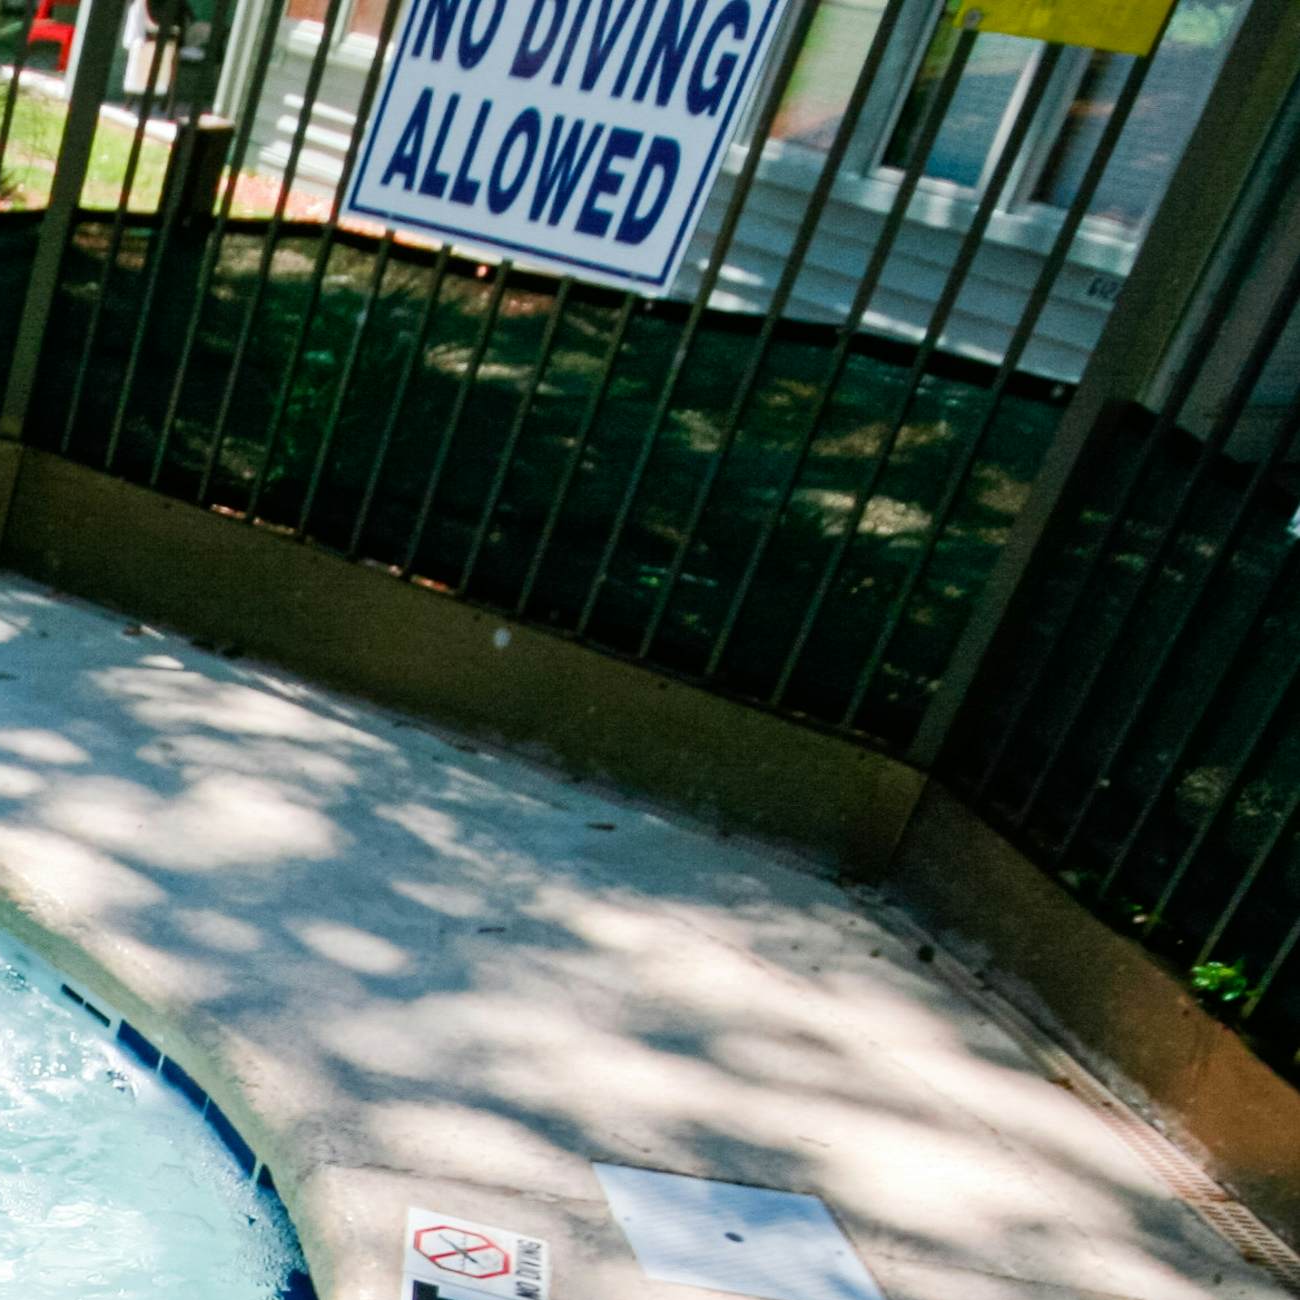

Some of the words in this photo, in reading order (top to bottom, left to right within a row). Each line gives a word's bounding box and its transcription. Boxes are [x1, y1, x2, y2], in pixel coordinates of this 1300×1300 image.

[411, 0, 508, 71] NO
[508, 0, 751, 117] DIVING
[380, 87, 681, 246] ALLOWED
